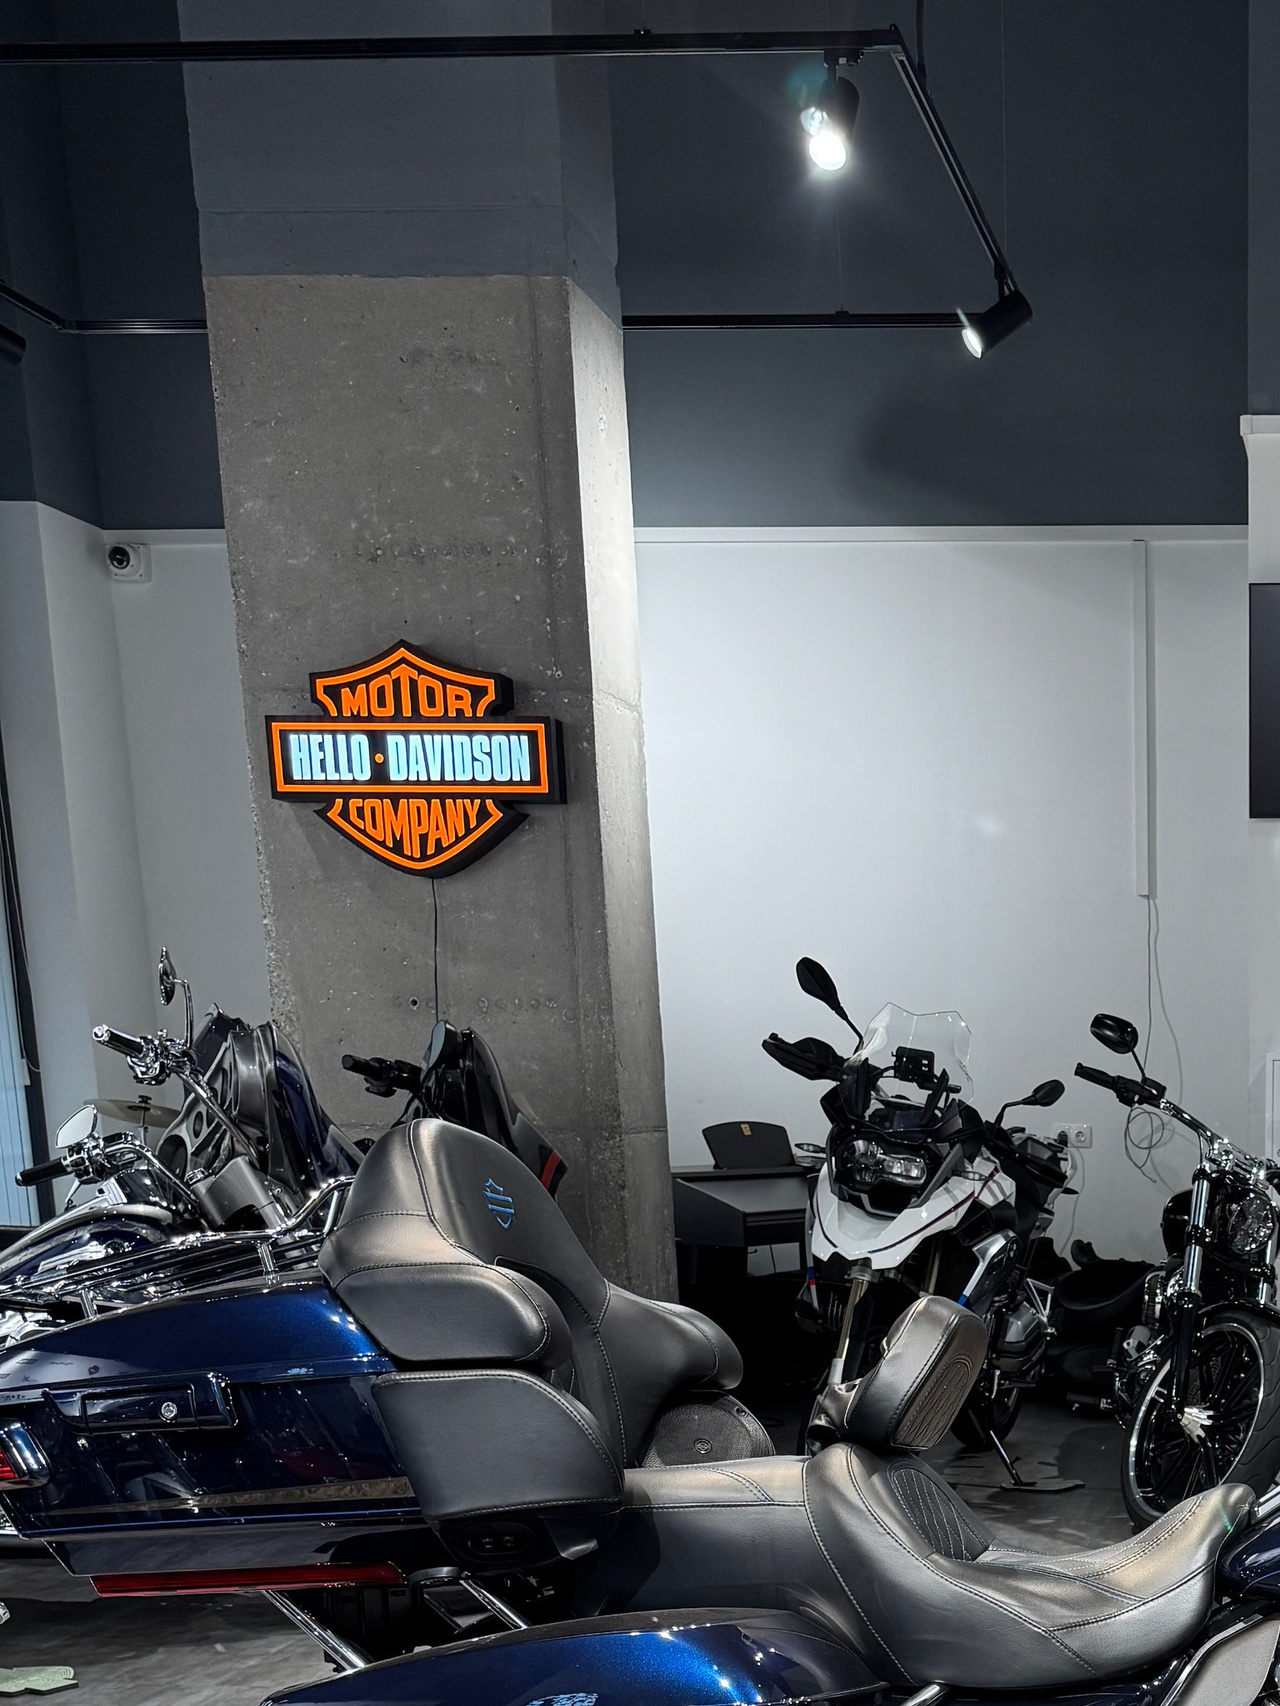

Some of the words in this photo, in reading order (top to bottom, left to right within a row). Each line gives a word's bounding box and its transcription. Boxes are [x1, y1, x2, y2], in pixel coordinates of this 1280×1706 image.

[341, 663, 472, 717] MOTOR
[289, 733, 372, 782] HELLO
[386, 734, 531, 783] DAVIDSON
[348, 798, 481, 859] COMPANY
